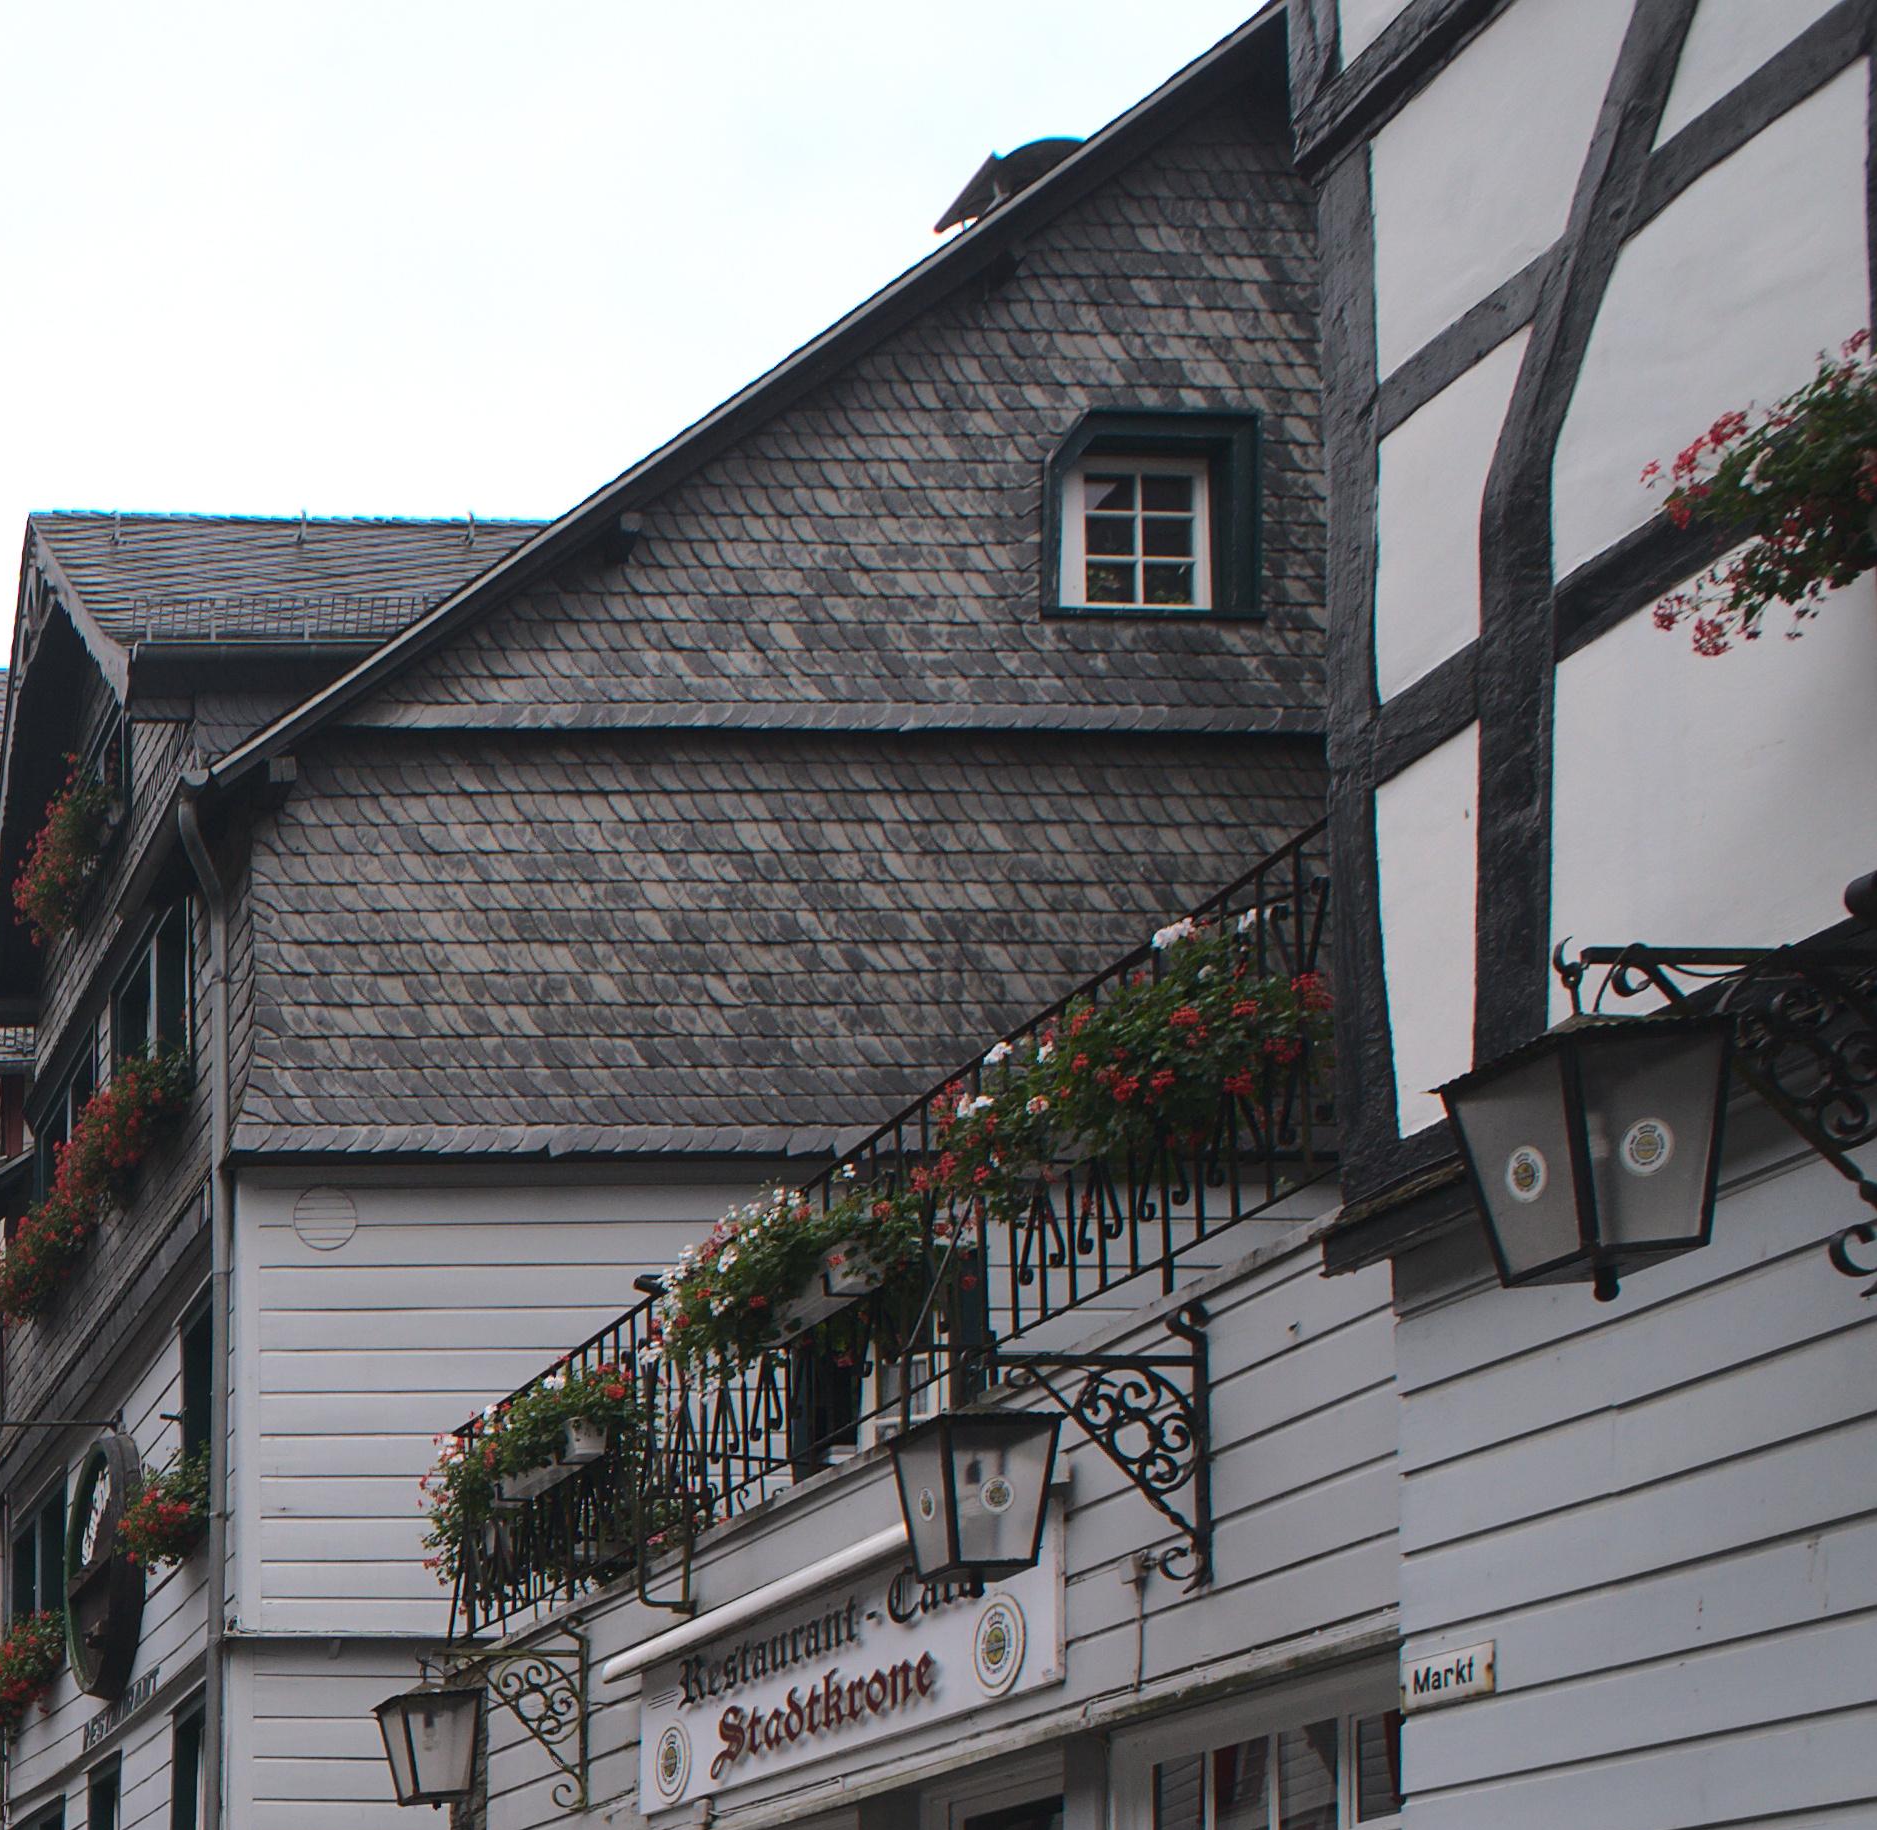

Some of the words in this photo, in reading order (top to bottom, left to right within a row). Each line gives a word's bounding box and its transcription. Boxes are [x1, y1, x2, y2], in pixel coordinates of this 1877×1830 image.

[678, 1597, 859, 1711] Restaurant
[1413, 1656, 1474, 1695] Markt
[710, 1650, 937, 1781] Stadtkrone
